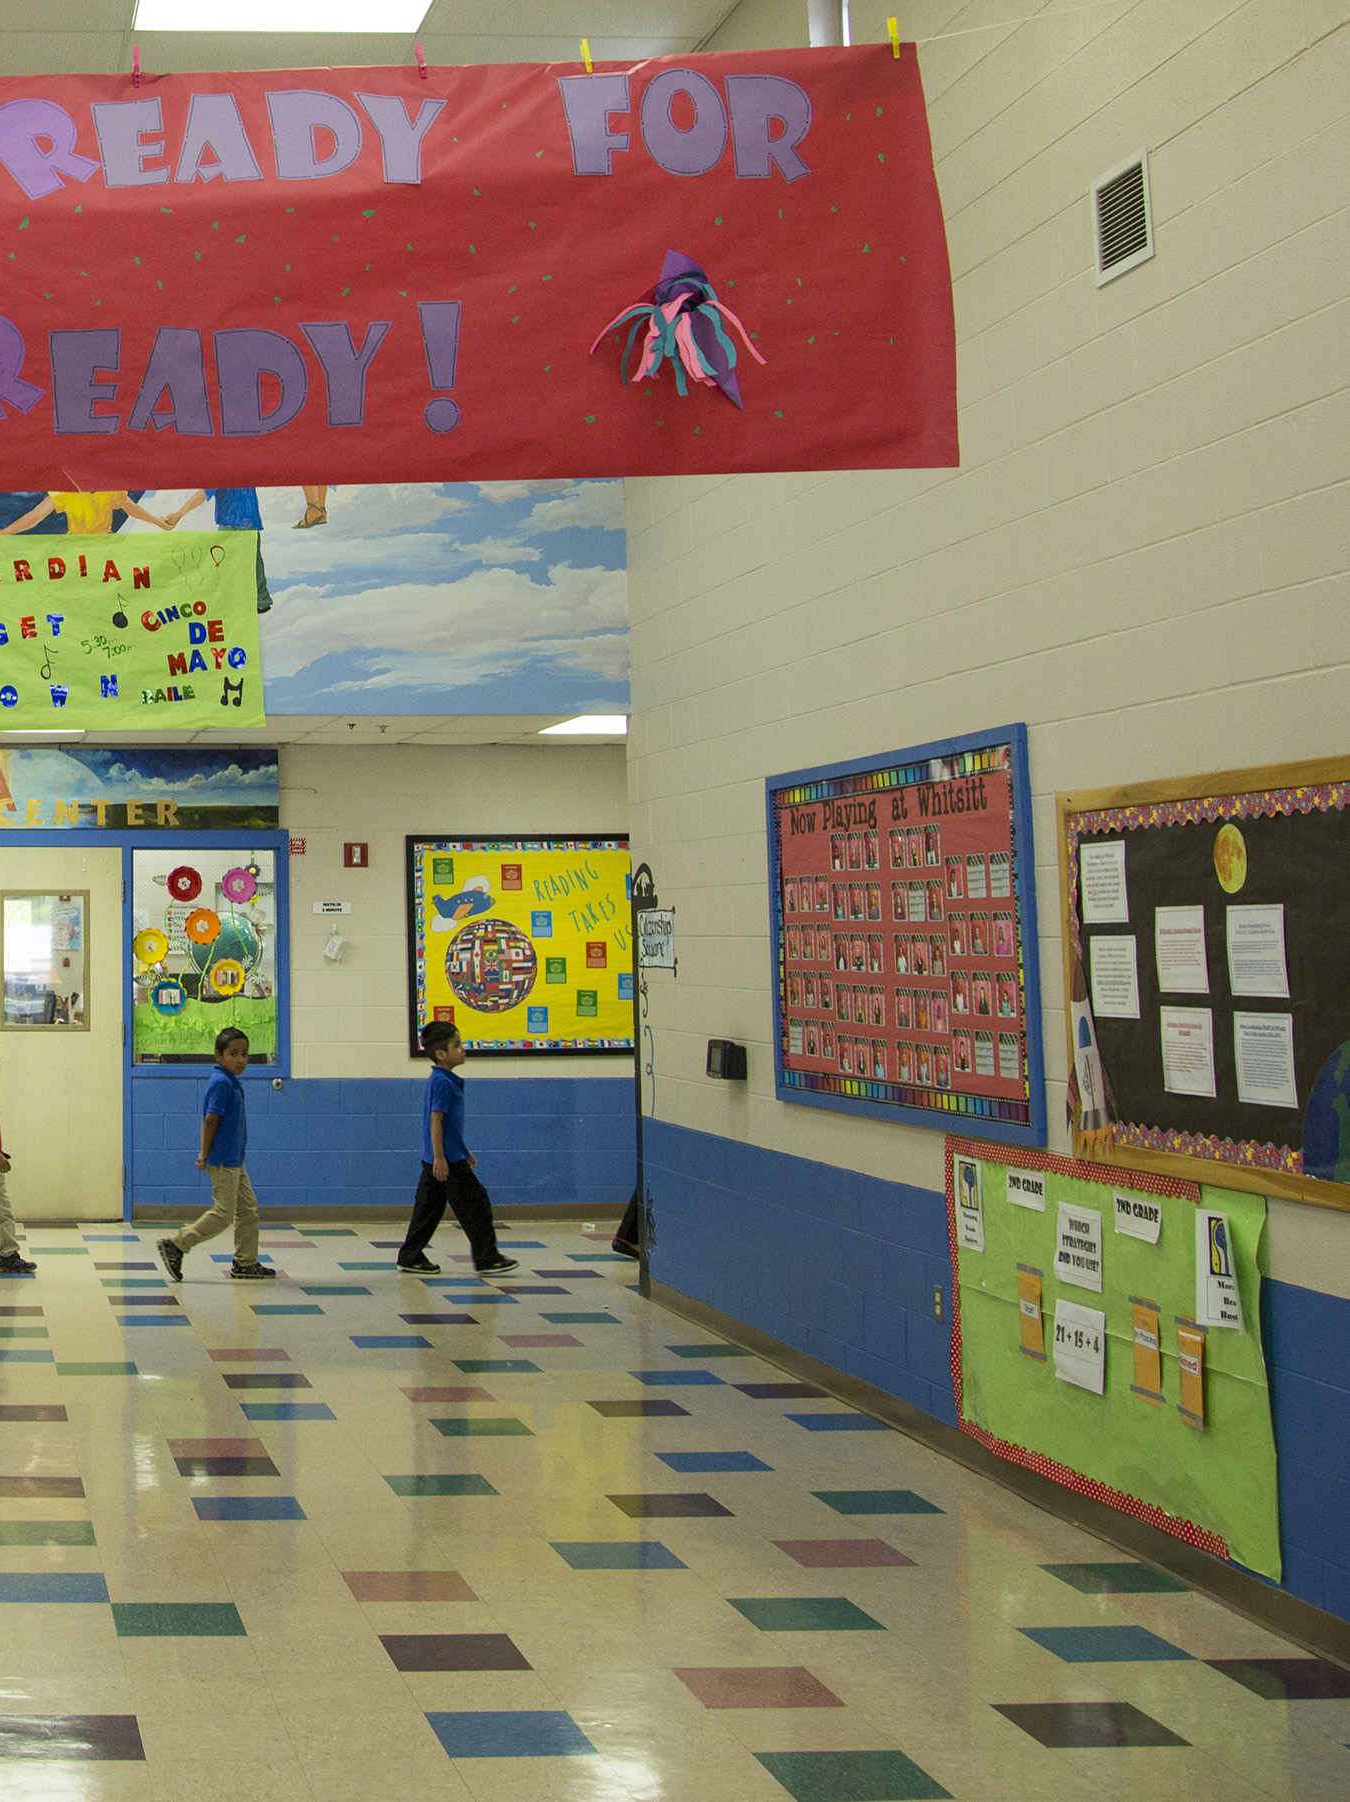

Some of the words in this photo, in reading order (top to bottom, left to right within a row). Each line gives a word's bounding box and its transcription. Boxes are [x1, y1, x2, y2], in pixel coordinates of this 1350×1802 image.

[558, 68, 812, 182] FOR
[141, 601, 206, 632] CINCO
[189, 619, 225, 645] DE
[167, 646, 247, 677] MAYO
[142, 685, 195, 704] BAILE
[790, 809, 816, 836] Now
[822, 797, 878, 831] Playing
[892, 793, 908, 822] at
[917, 776, 988, 818] Whitsitt
[533, 860, 599, 902] READING
[569, 893, 616, 933] TAKES
[1008, 1174, 1021, 1190] 2ND
[1022, 1178, 1044, 1196] GRADE
[1116, 1198, 1131, 1215] 2ND
[1132, 1203, 1159, 1223] GRADE
[1068, 1218, 1090, 1234] WHICH
[1062, 1234, 1097, 1254] STRATEGIES
[1058, 1250, 1071, 1264] DID
[1072, 1254, 1085, 1269] YOU
[1055, 1324, 1065, 1343] 21
[1074, 1329, 1084, 1349] 15
[1093, 1335, 1100, 1353] 4
